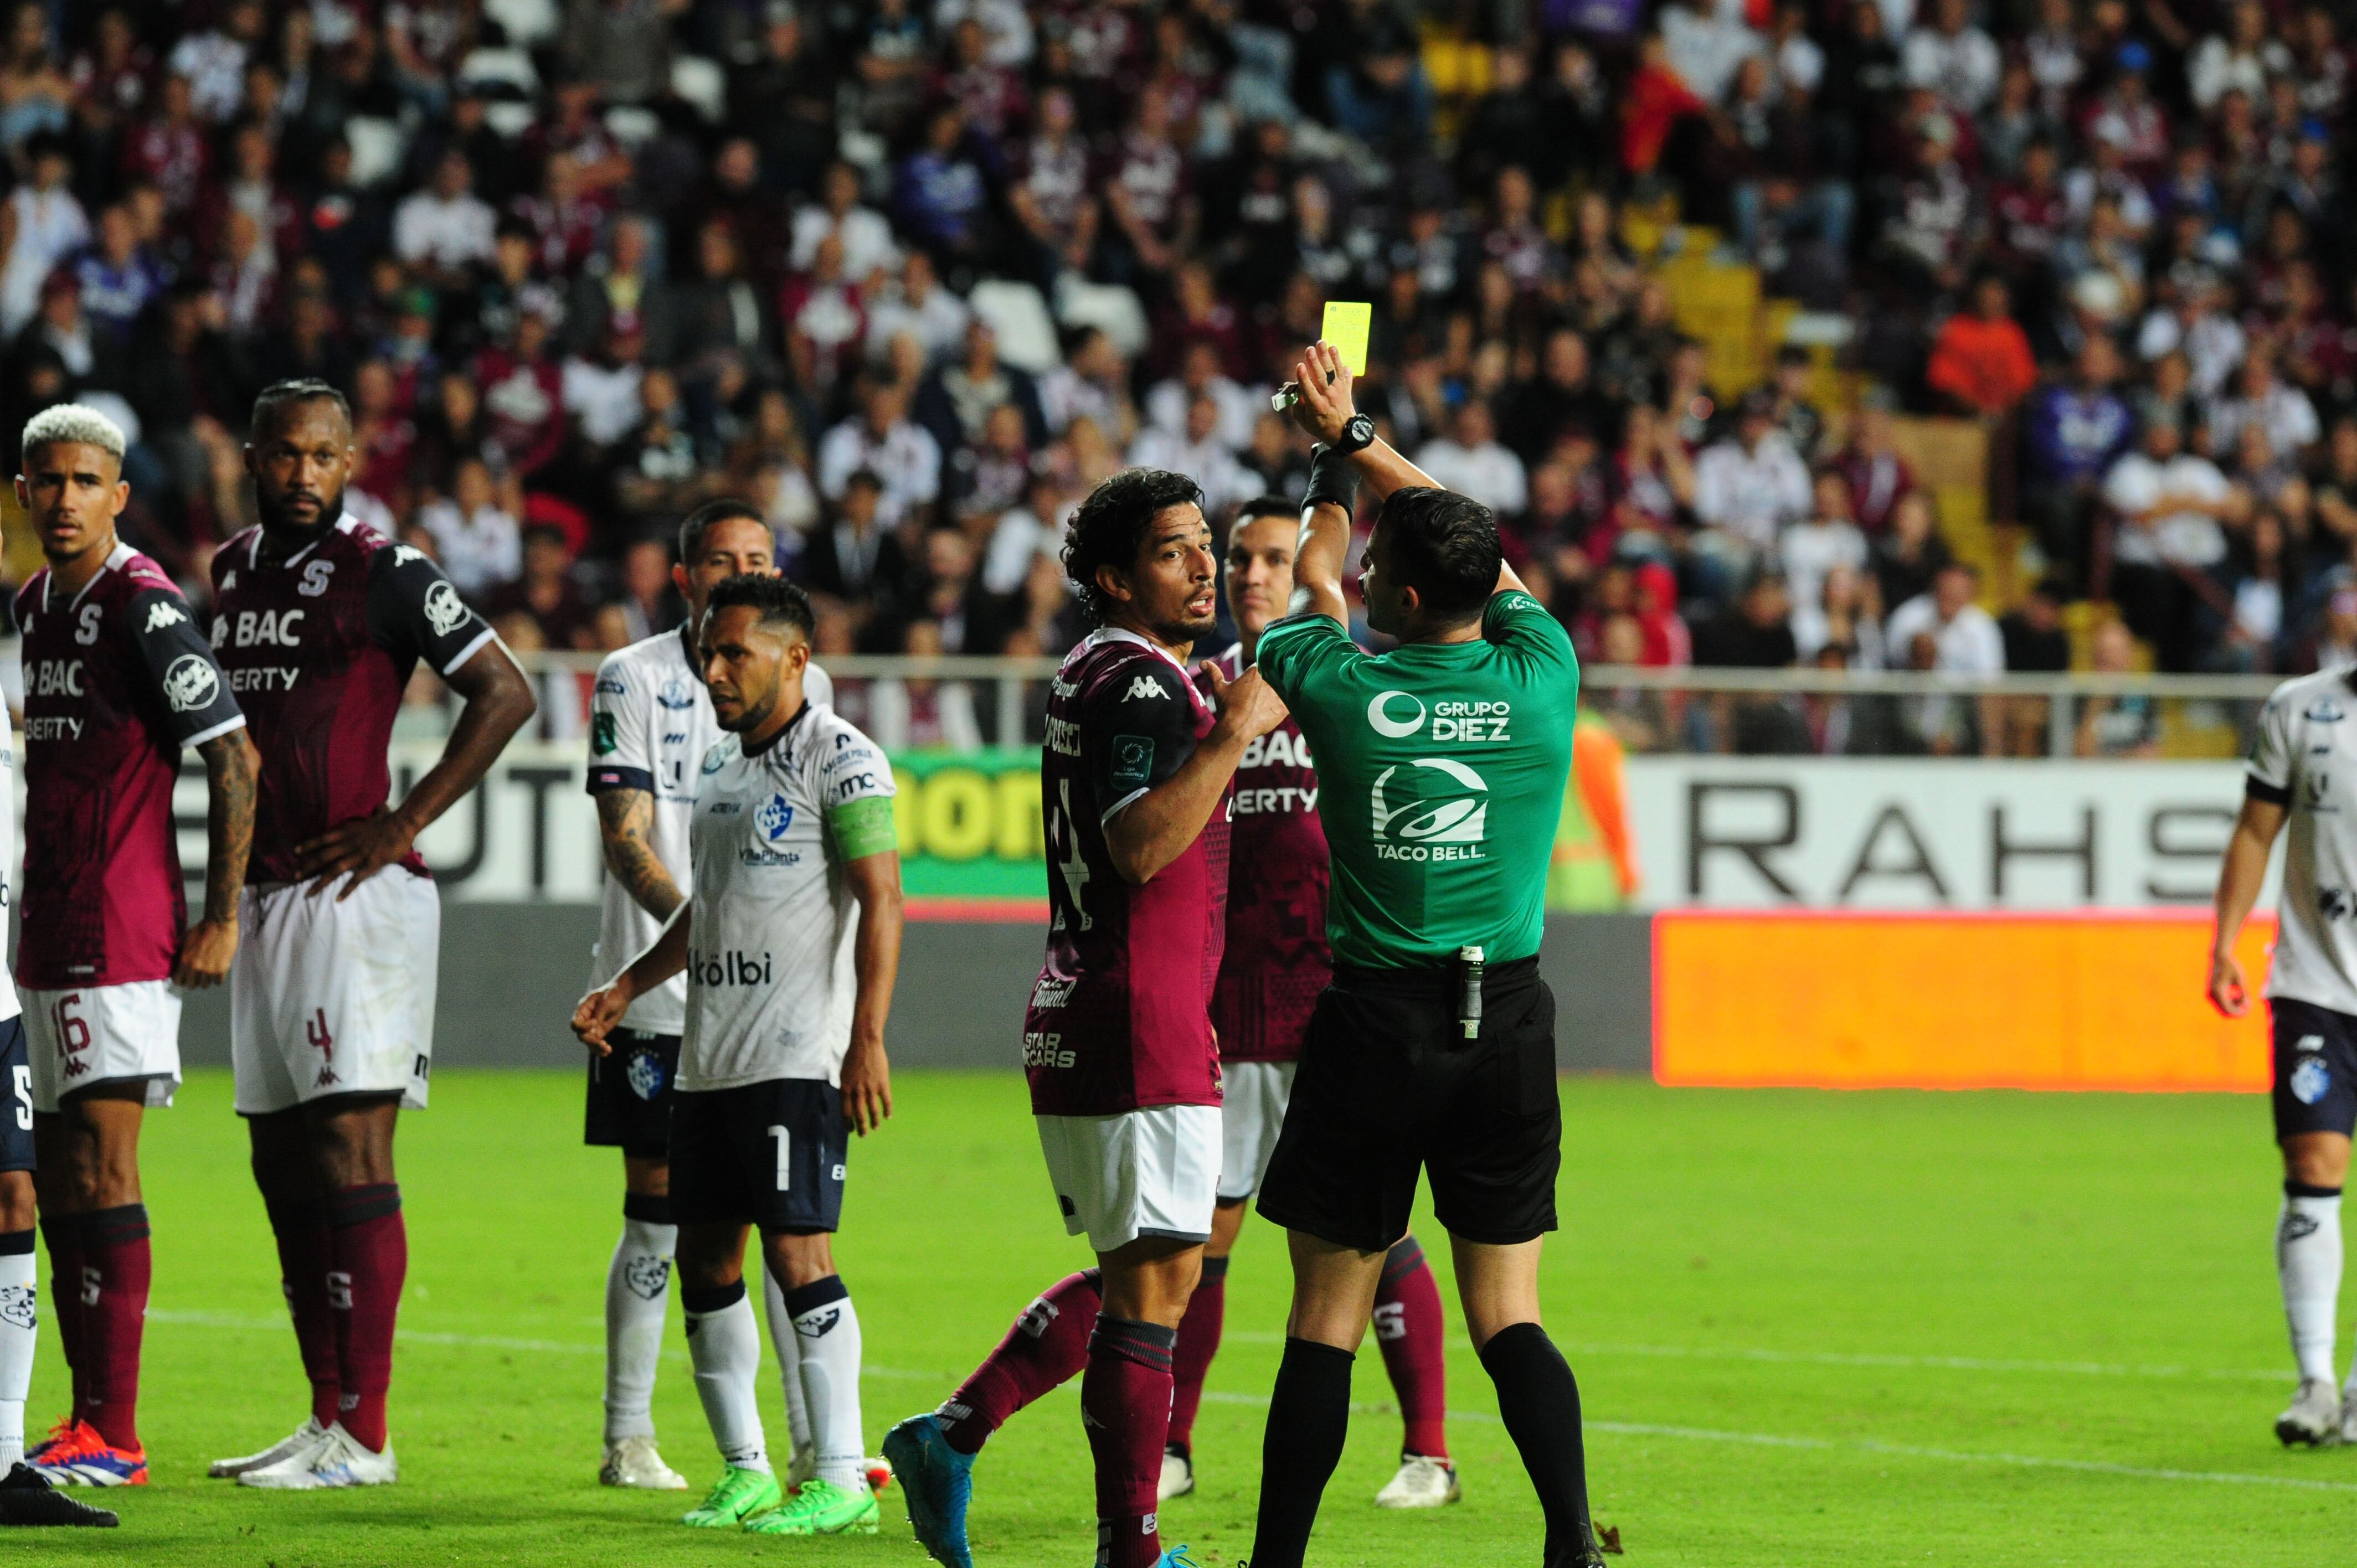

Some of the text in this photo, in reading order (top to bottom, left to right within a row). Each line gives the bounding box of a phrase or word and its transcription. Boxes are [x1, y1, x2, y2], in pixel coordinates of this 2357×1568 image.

[235, 609, 305, 647] BAC
[38, 659, 83, 697] BAC
[223, 667, 299, 691] ERTY
[1434, 701, 1510, 716] GRUPO
[25, 717, 83, 741] BERTY
[1433, 718, 1510, 742] DIEZ
[1232, 787, 1318, 814] ERTY
[1374, 844, 1428, 862] TACO
[50, 994, 91, 1058] 16
[307, 1008, 332, 1062] 4
[768, 1125, 790, 1191] 1
